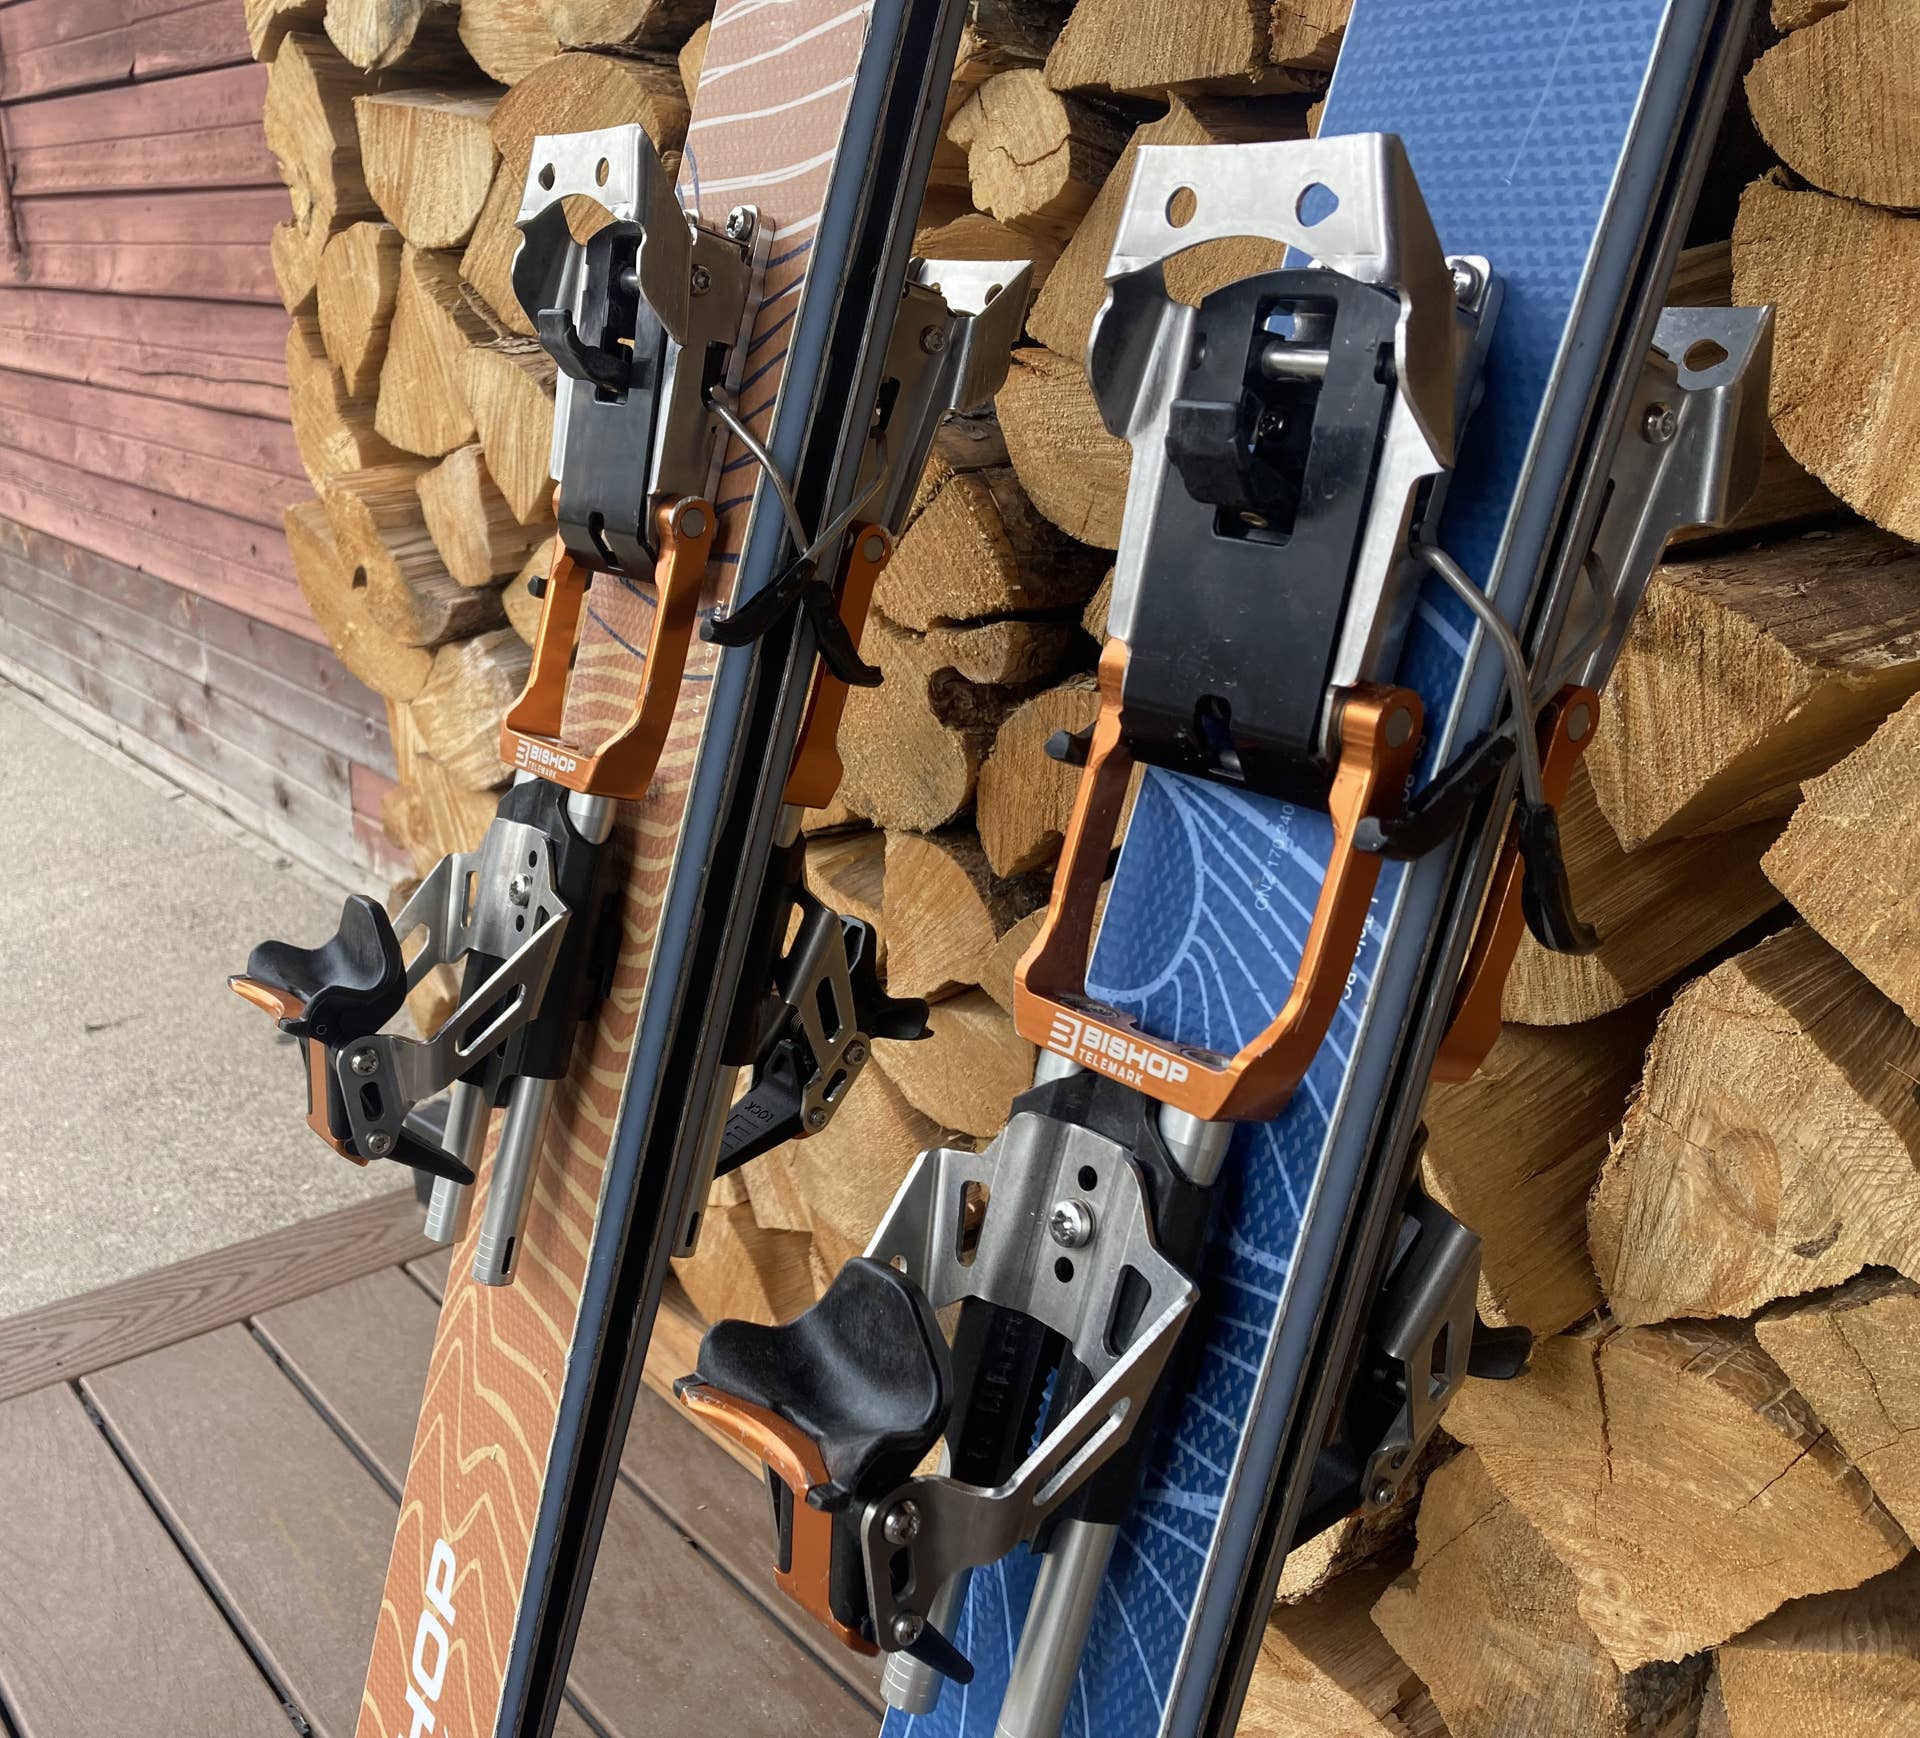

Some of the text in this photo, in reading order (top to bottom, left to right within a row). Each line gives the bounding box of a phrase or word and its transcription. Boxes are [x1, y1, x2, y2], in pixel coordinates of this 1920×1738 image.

[528, 760, 558, 779] TELEMARK
[530, 745, 577, 773] BISHOP
[1267, 839, 1286, 867] 170
[1078, 1047, 1144, 1088] TELEMARK
[1080, 1023, 1189, 1084] BISHOP
